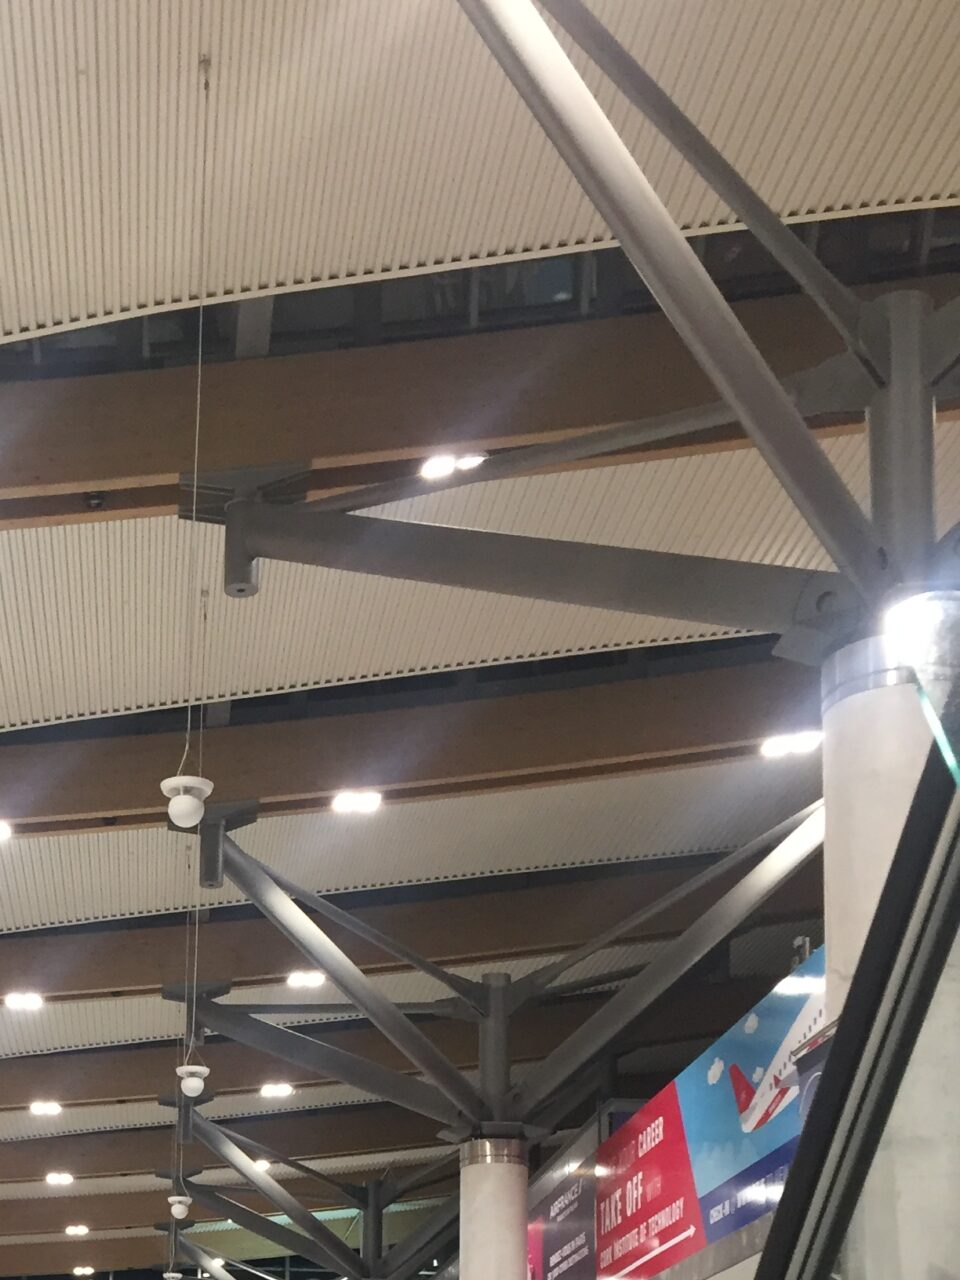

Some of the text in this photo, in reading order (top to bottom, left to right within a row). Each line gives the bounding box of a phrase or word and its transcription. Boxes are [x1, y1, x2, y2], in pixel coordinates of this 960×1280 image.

[638, 1116, 664, 1158] CAREER
[600, 1188, 622, 1236] TAKE
[626, 1171, 643, 1217] OFF
[648, 1196, 685, 1236] TECHNOLOGY
